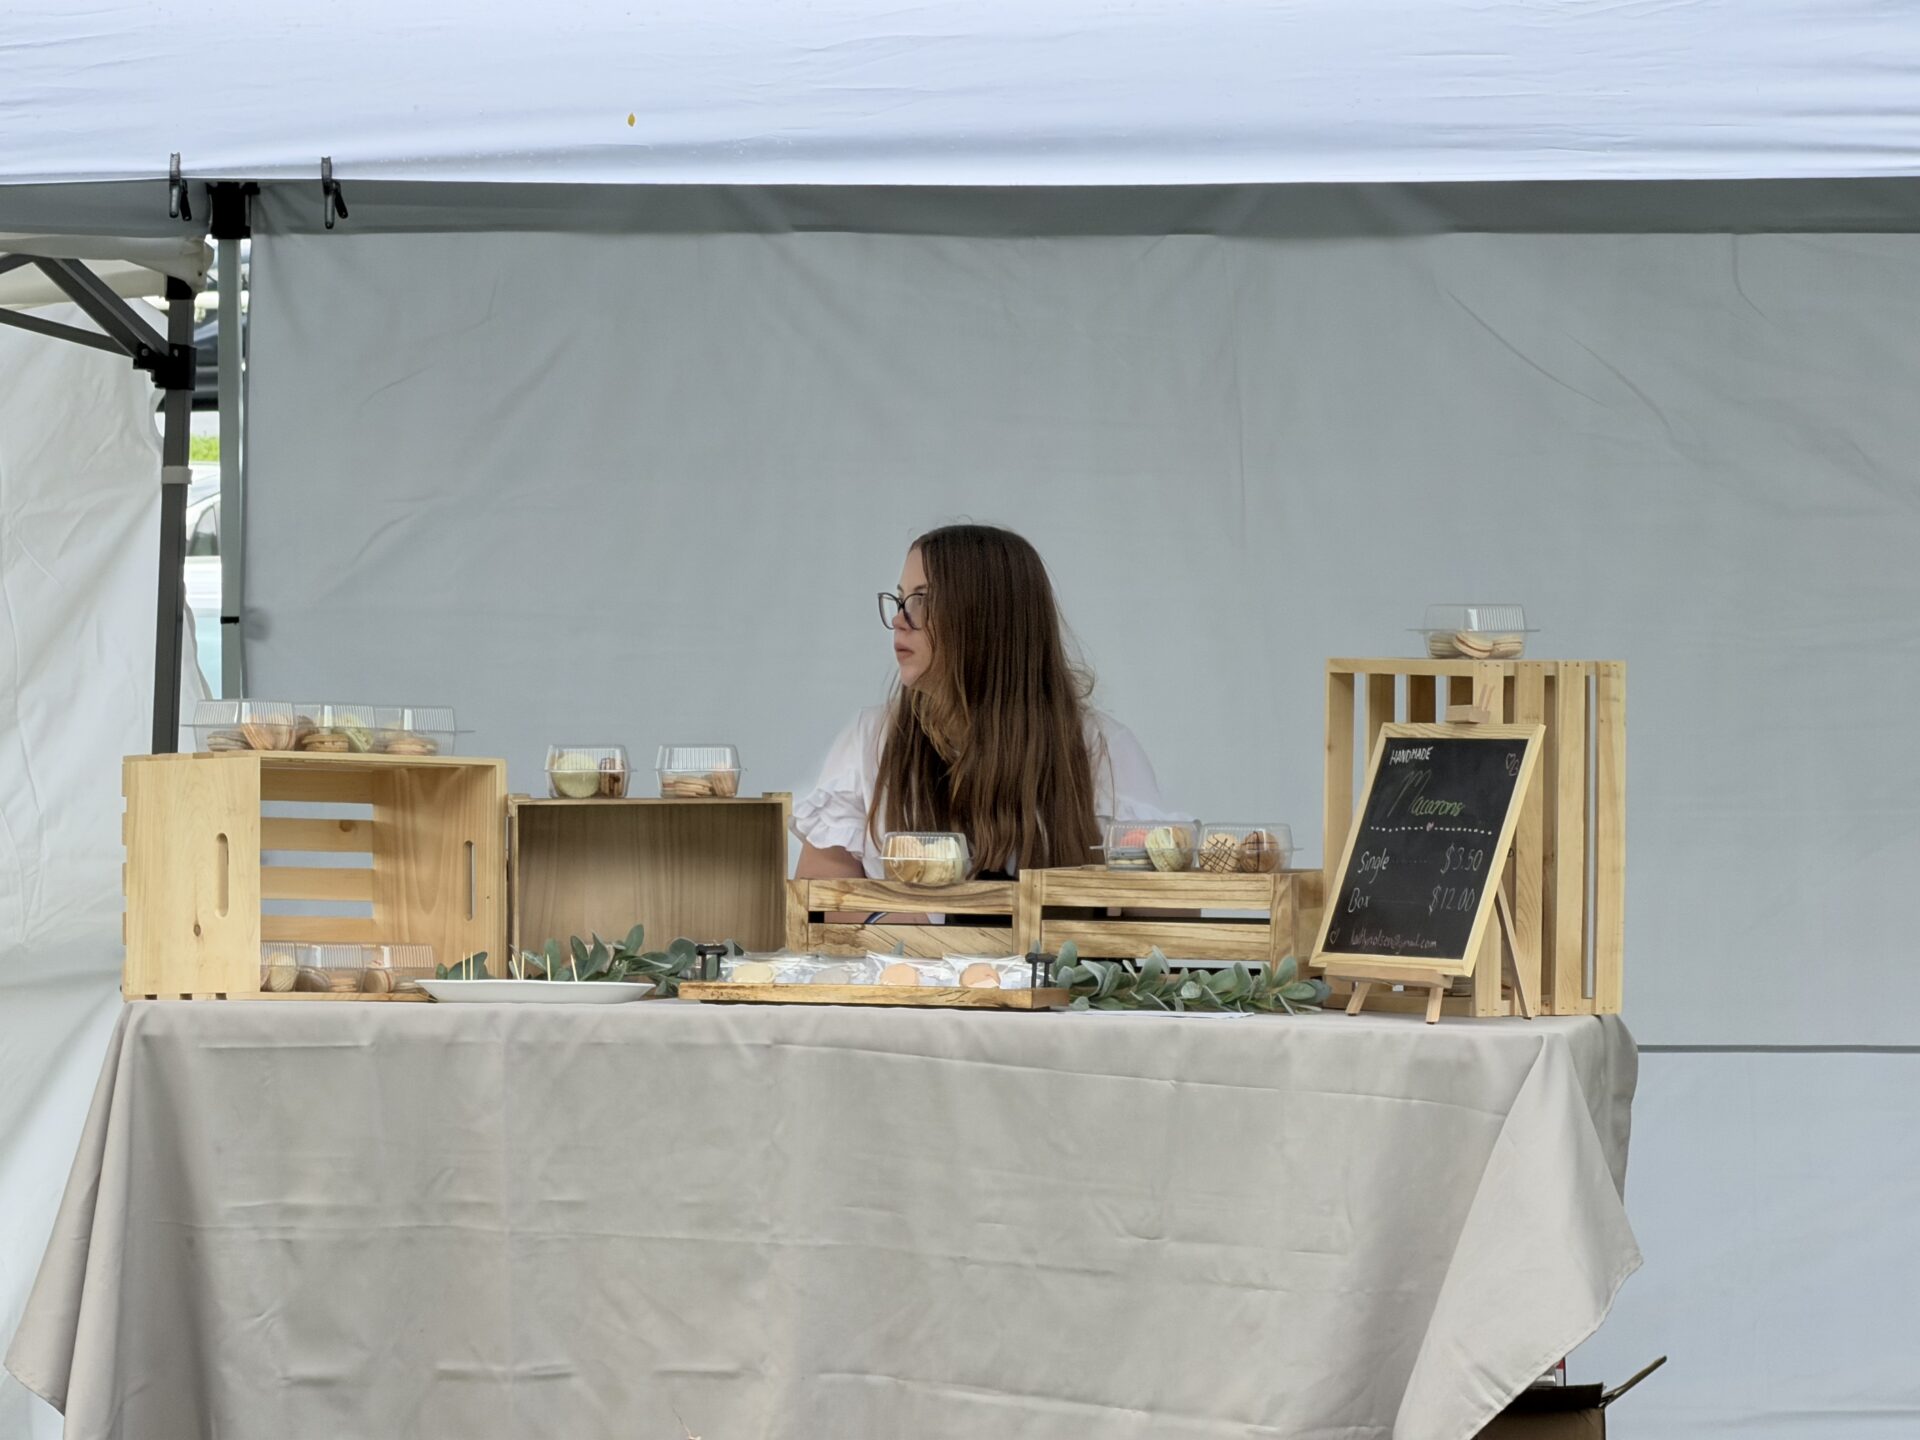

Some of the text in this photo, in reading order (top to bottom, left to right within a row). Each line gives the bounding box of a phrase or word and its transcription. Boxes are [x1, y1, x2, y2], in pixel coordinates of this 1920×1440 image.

[1389, 746, 1434, 766] HANDMADE
[1387, 769, 1465, 818] Macarons
[1357, 842, 1484, 884] Single $3.50
[1348, 884, 1476, 915] Box $12.00
